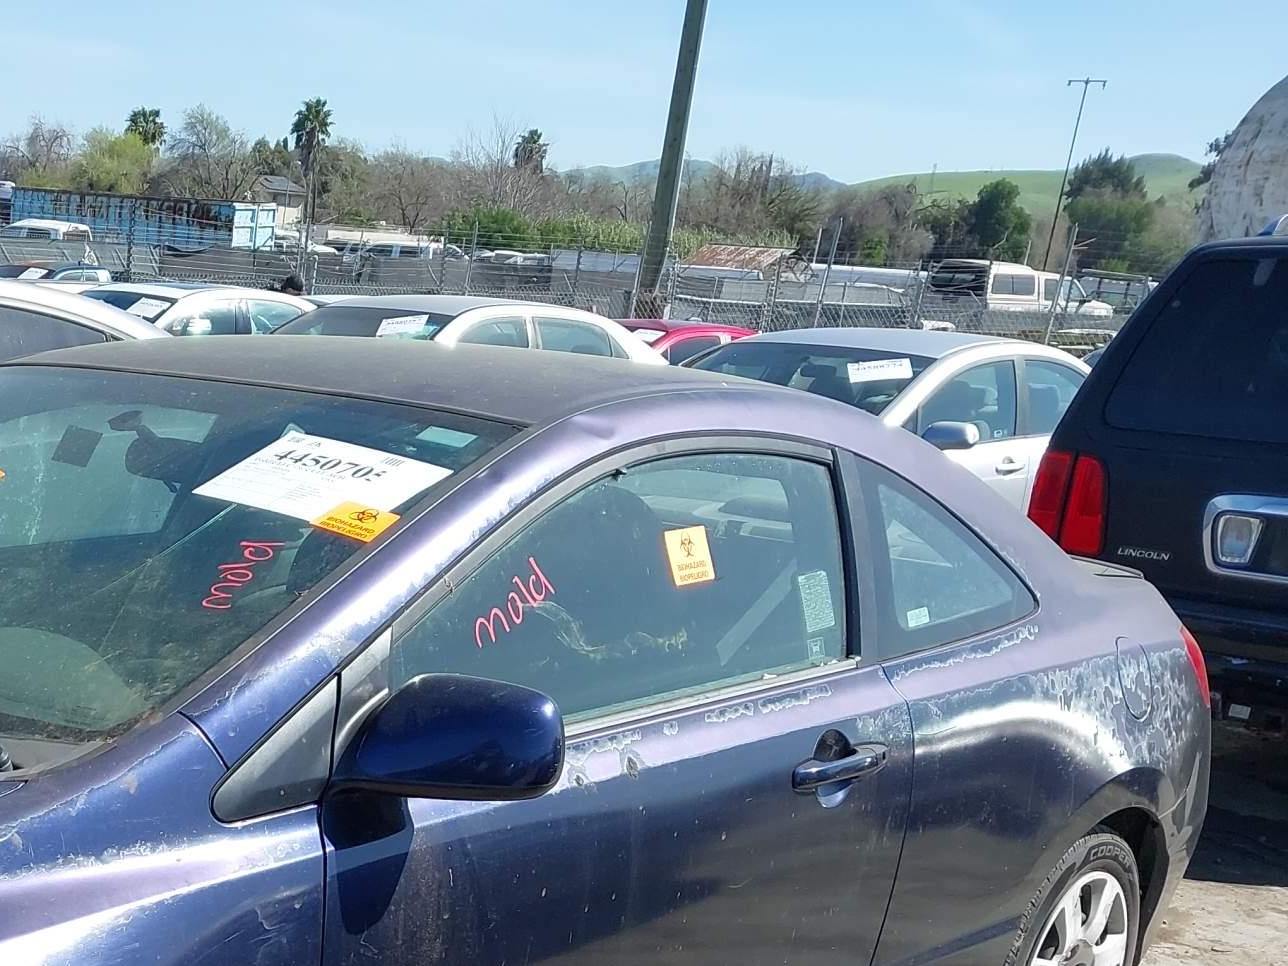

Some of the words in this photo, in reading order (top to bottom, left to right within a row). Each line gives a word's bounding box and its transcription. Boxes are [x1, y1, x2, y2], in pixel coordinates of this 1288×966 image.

[201, 540, 286, 610] mold
[1117, 547, 1170, 560] LINCOLN
[474, 555, 556, 649] mold
[1090, 845, 1130, 868] COOPER
